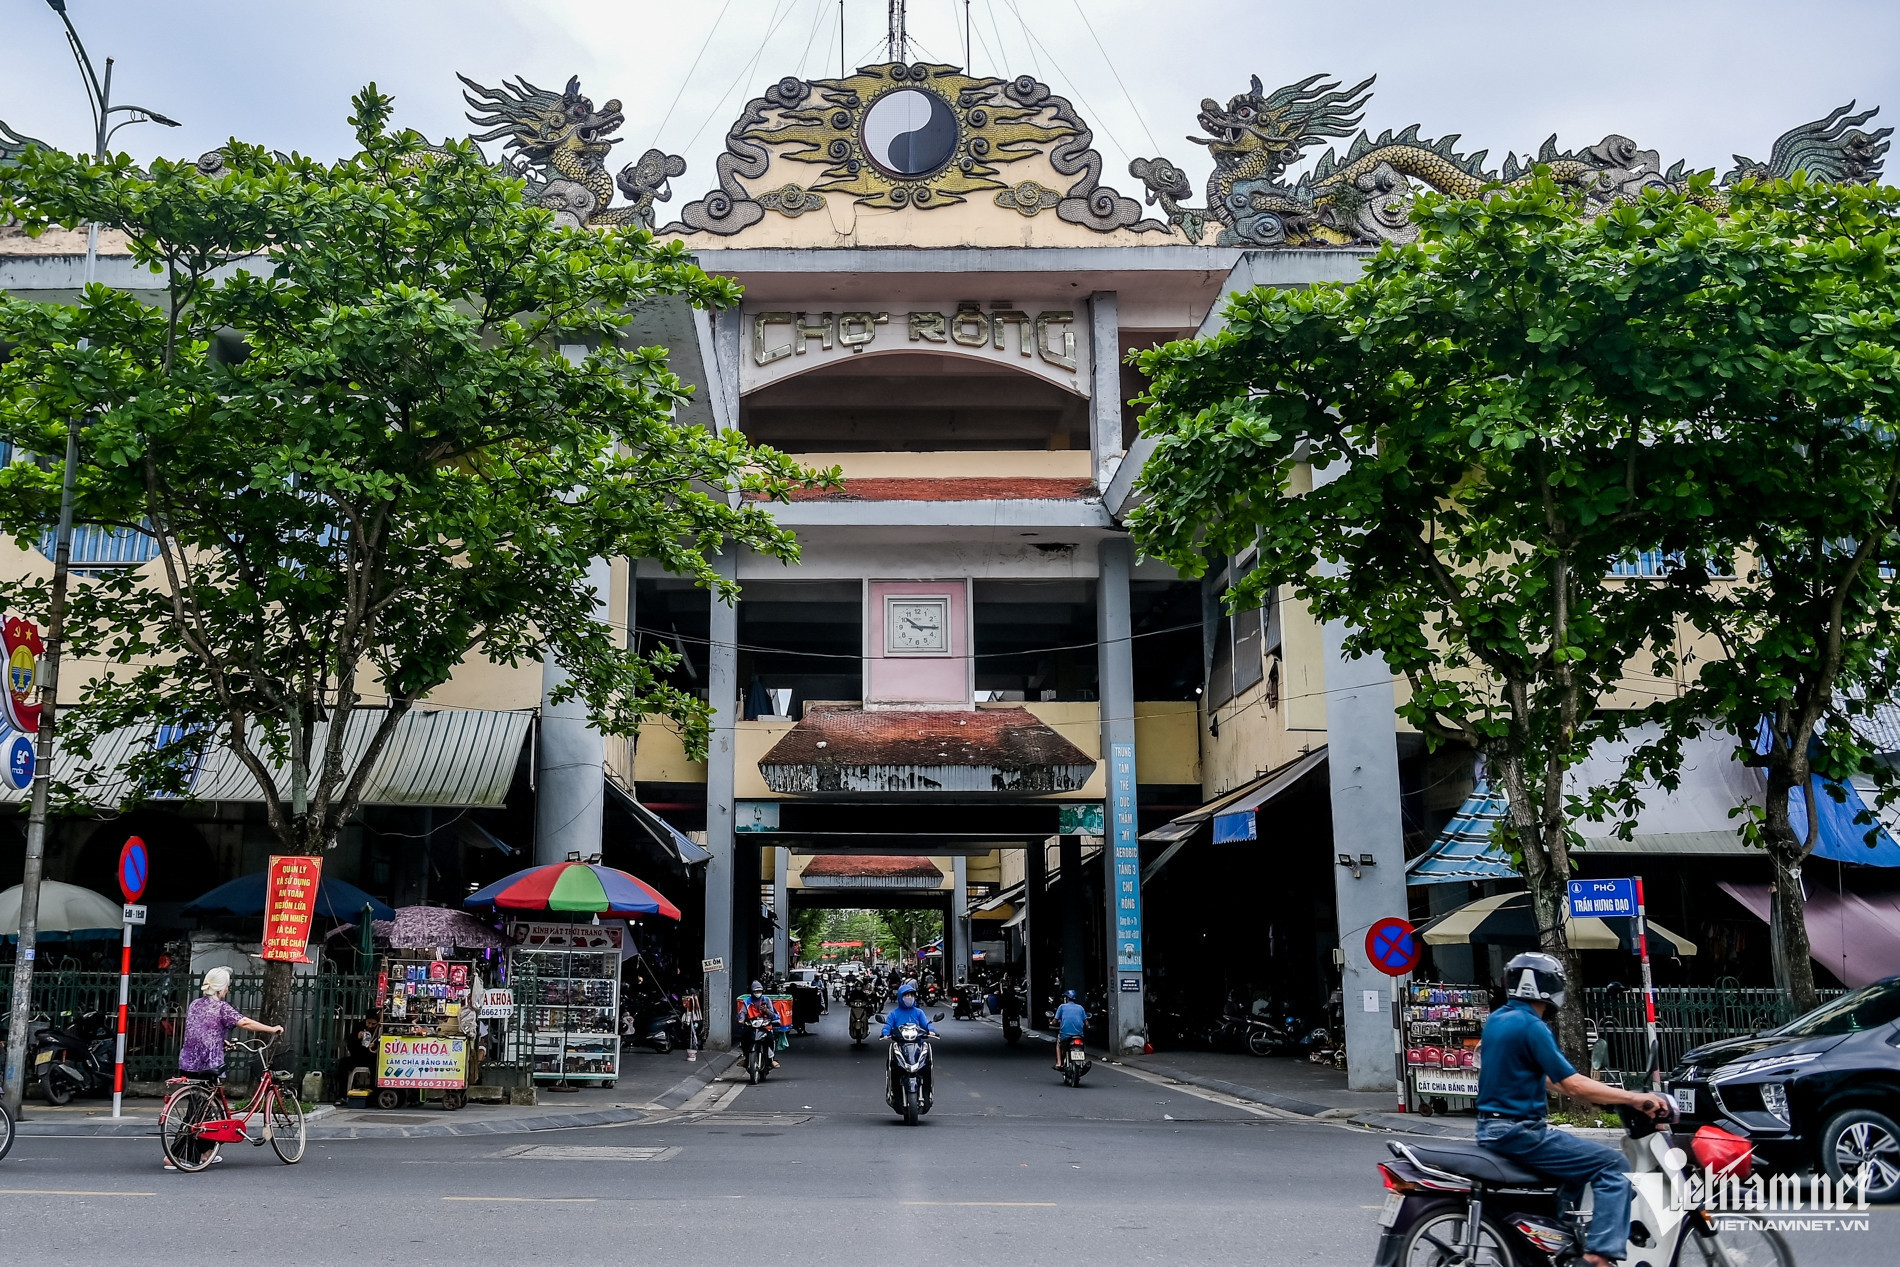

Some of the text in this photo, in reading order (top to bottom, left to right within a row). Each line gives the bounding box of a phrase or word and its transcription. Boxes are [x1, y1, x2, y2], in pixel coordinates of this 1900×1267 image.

[754, 302, 1077, 373] CHỢ RỒNG
[1115, 746, 1131, 758] TRUNG
[1594, 881, 1616, 892] PHỐ
[490, 990, 512, 1005] KHÓA
[384, 1038, 448, 1055] SỬA KHÓA
[421, 1057, 441, 1066] BẰNG
[1418, 1080, 1430, 1090] CẮT
[1432, 1082, 1446, 1091] CHÌA
[1467, 1082, 1479, 1093] MÁ
